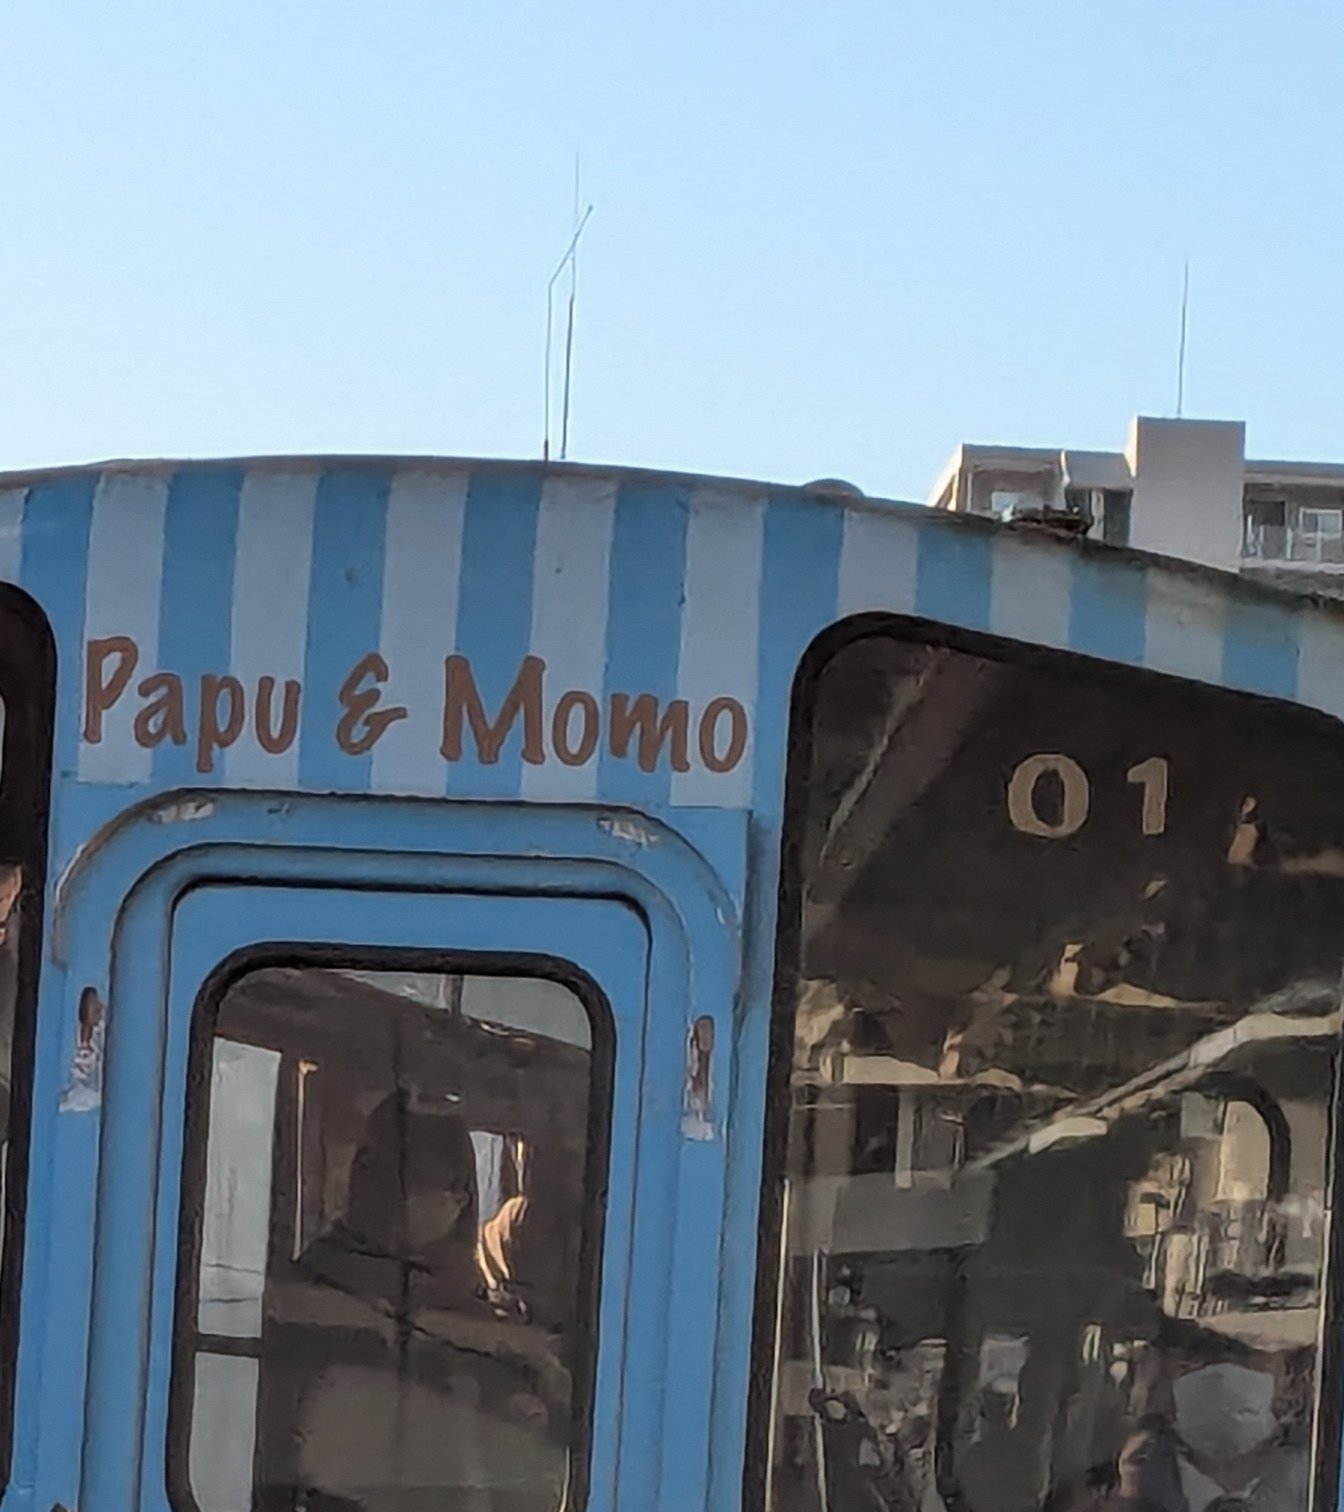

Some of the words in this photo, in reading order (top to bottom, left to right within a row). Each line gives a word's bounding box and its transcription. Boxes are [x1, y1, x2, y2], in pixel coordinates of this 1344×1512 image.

[83, 635, 302, 774] Papu
[335, 651, 409, 757] &
[438, 652, 750, 775] Momo
